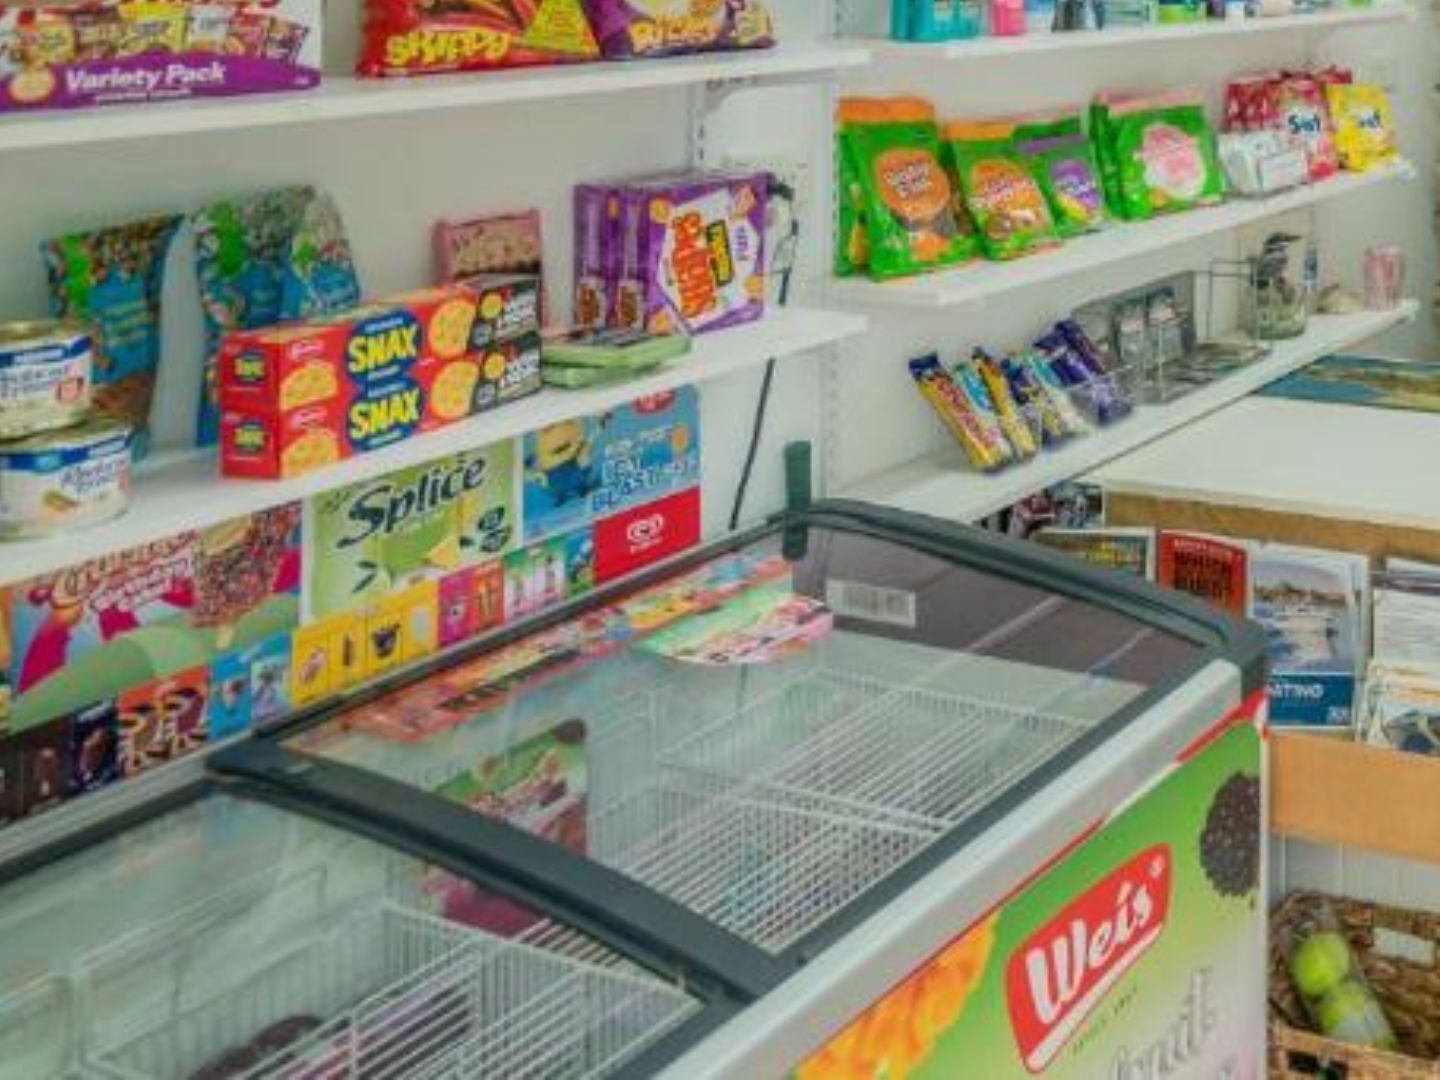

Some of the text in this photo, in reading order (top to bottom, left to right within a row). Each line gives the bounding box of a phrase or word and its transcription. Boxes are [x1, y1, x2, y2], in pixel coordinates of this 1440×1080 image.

[65, 61, 228, 96] Variety Pack
[348, 322, 418, 374] SNAX
[350, 386, 421, 440] SNAX
[335, 453, 486, 549] Splice
[1024, 880, 1155, 1025] Weis
